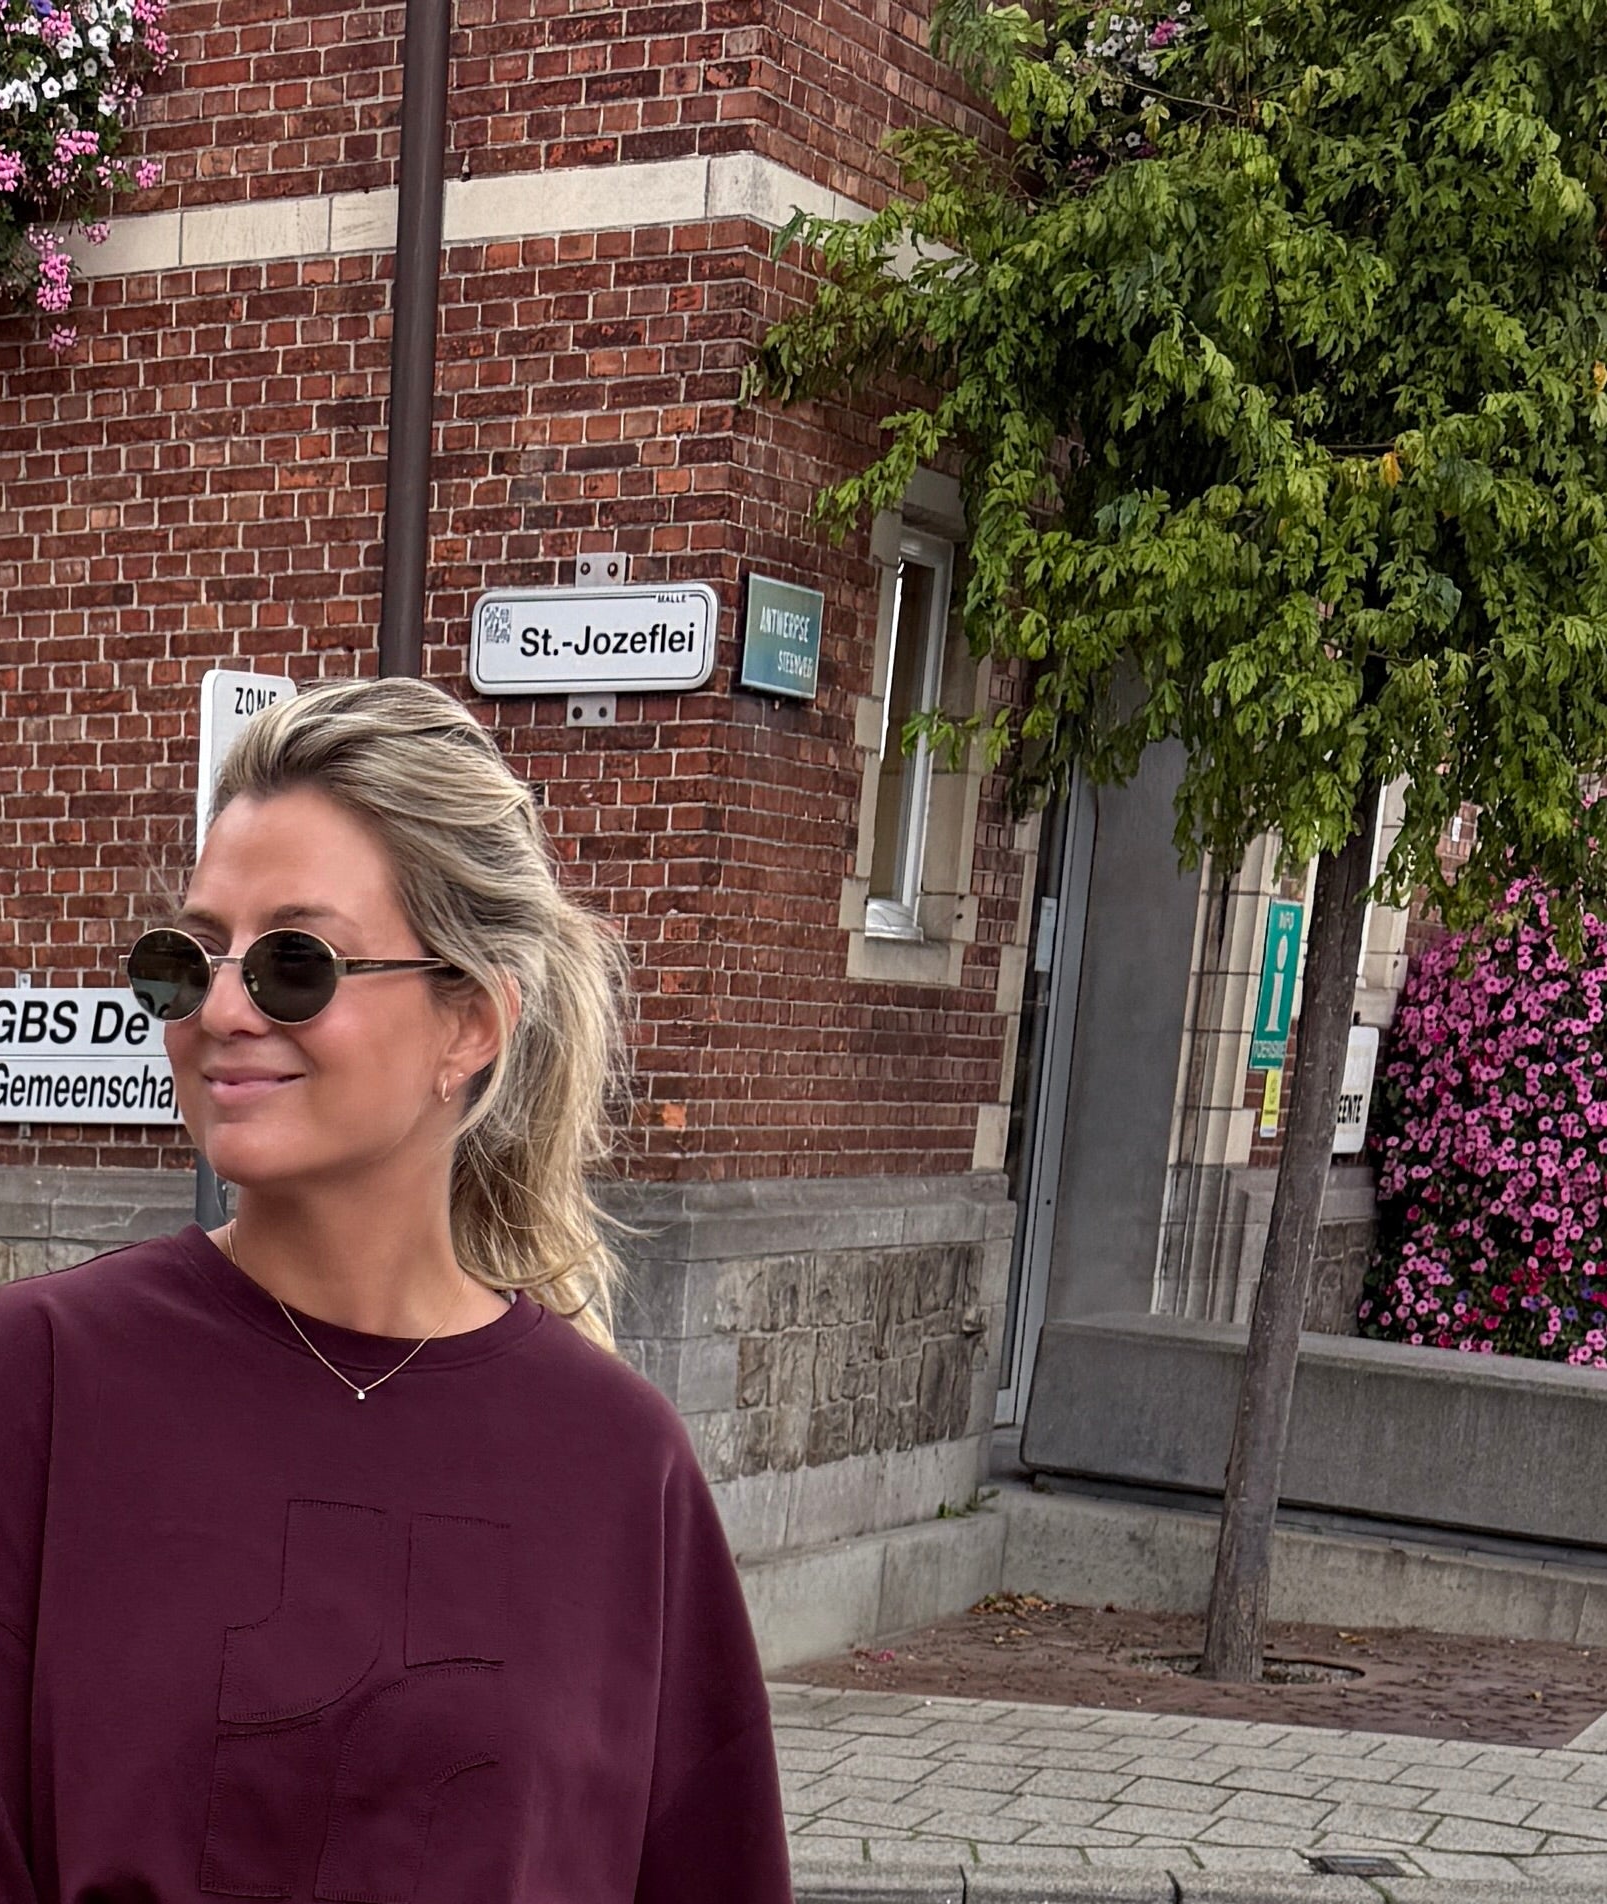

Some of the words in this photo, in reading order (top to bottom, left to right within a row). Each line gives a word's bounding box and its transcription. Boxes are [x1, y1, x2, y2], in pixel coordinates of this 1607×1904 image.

[520, 622, 695, 657] St.-Jozeflei
[759, 605, 810, 643] ANTWERPSE
[235, 687, 277, 716] ZONE
[91, 1001, 150, 1045] De
[1337, 1094, 1364, 1124] EENTE
